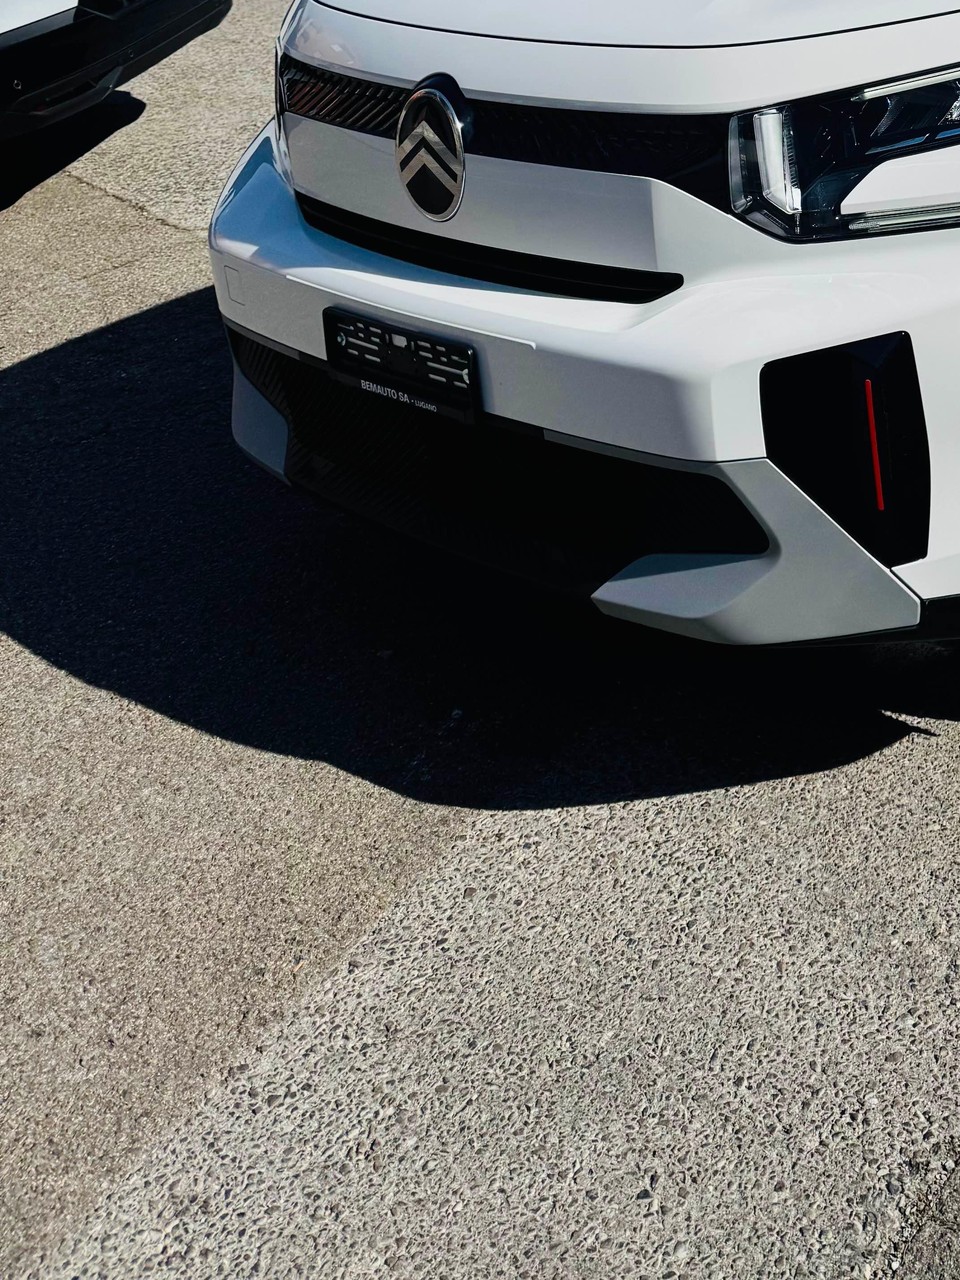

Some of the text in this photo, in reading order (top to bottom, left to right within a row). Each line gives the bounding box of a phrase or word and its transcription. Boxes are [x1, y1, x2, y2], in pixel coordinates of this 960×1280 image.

[360, 380, 397, 399] BEMAUTO
[398, 392, 409, 403] SA
[415, 400, 437, 412] LUGANO
